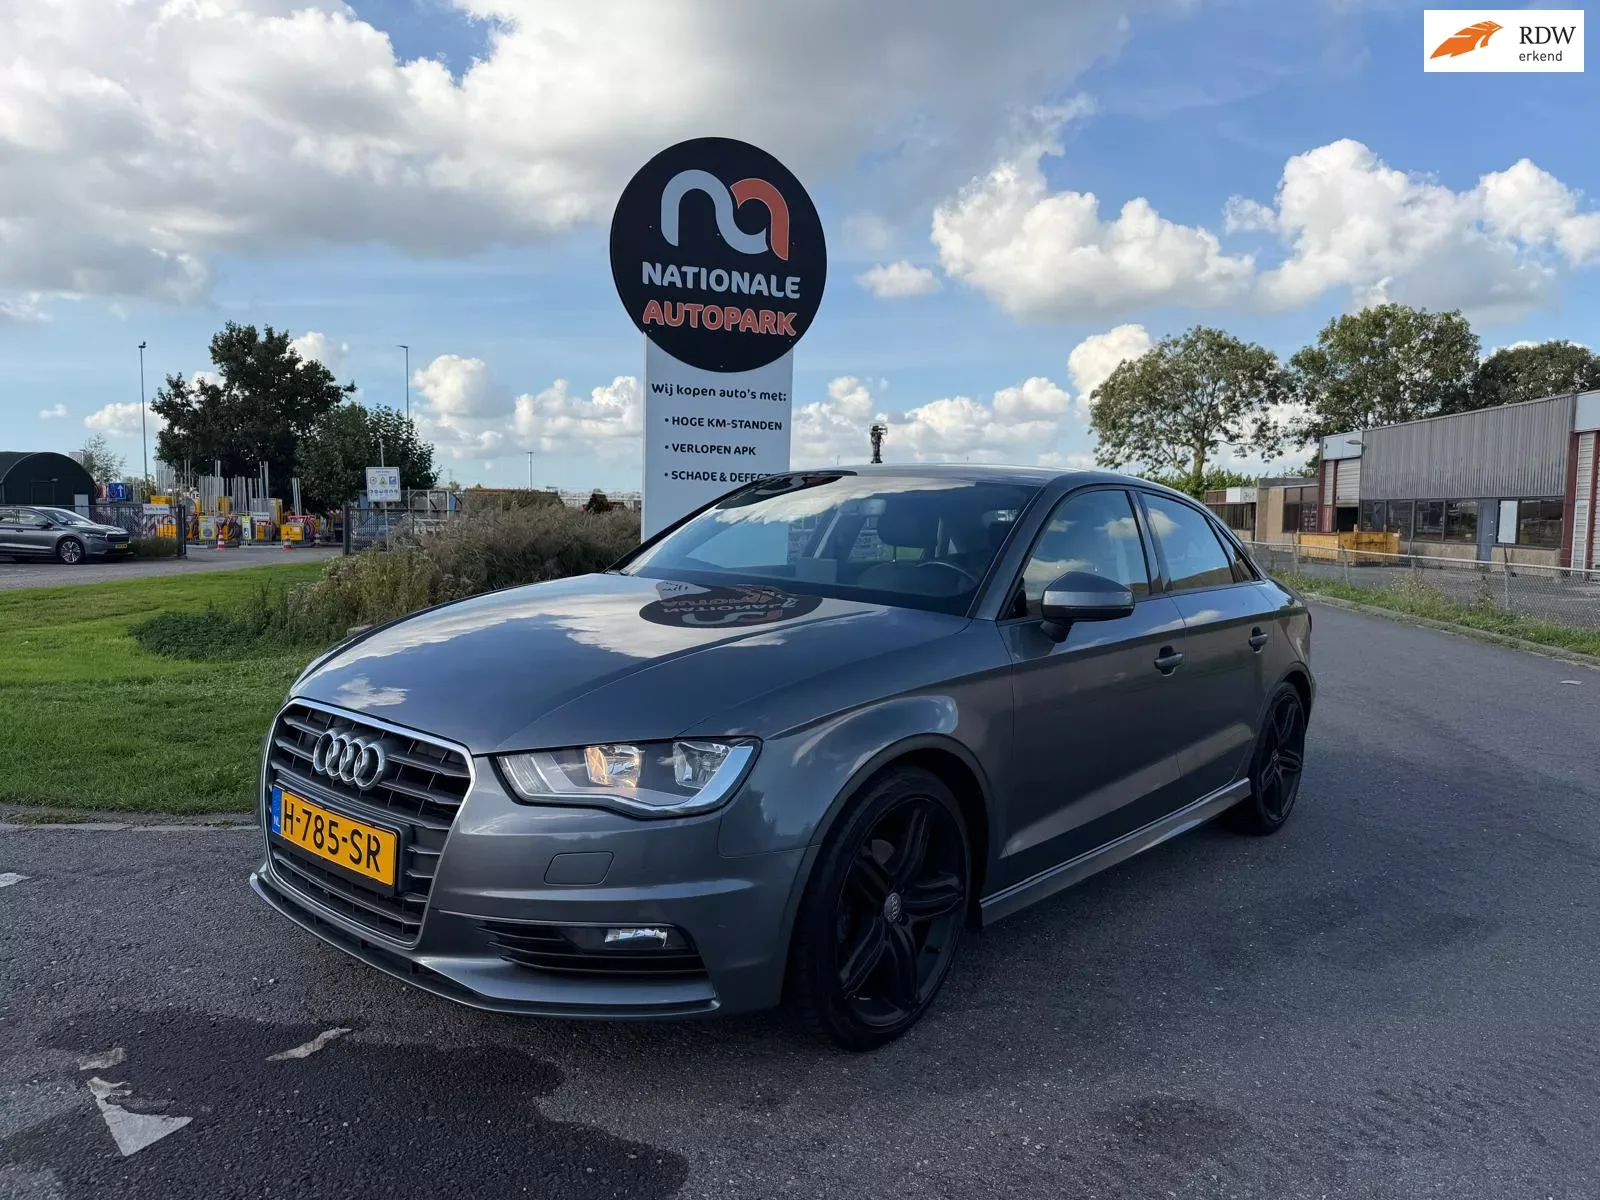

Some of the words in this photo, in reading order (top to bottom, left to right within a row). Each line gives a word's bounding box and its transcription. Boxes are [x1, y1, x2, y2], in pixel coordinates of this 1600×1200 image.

[642, 261, 801, 299] NATIONALE
[643, 299, 797, 336] AUTOPARK
[652, 383, 673, 396] Wij
[677, 384, 717, 397] kopen
[719, 388, 757, 399] auto's
[760, 391, 787, 402] met:
[672, 416, 704, 427] HOGE
[708, 418, 782, 430] KM-STANDEN
[672, 443, 731, 454] VERLOPEN
[734, 446, 757, 455] APK
[671, 471, 717, 481] SCHADE
[719, 472, 727, 482] &
[273, 815, 281, 827] NL
[283, 799, 381, 873] H-785-SR
